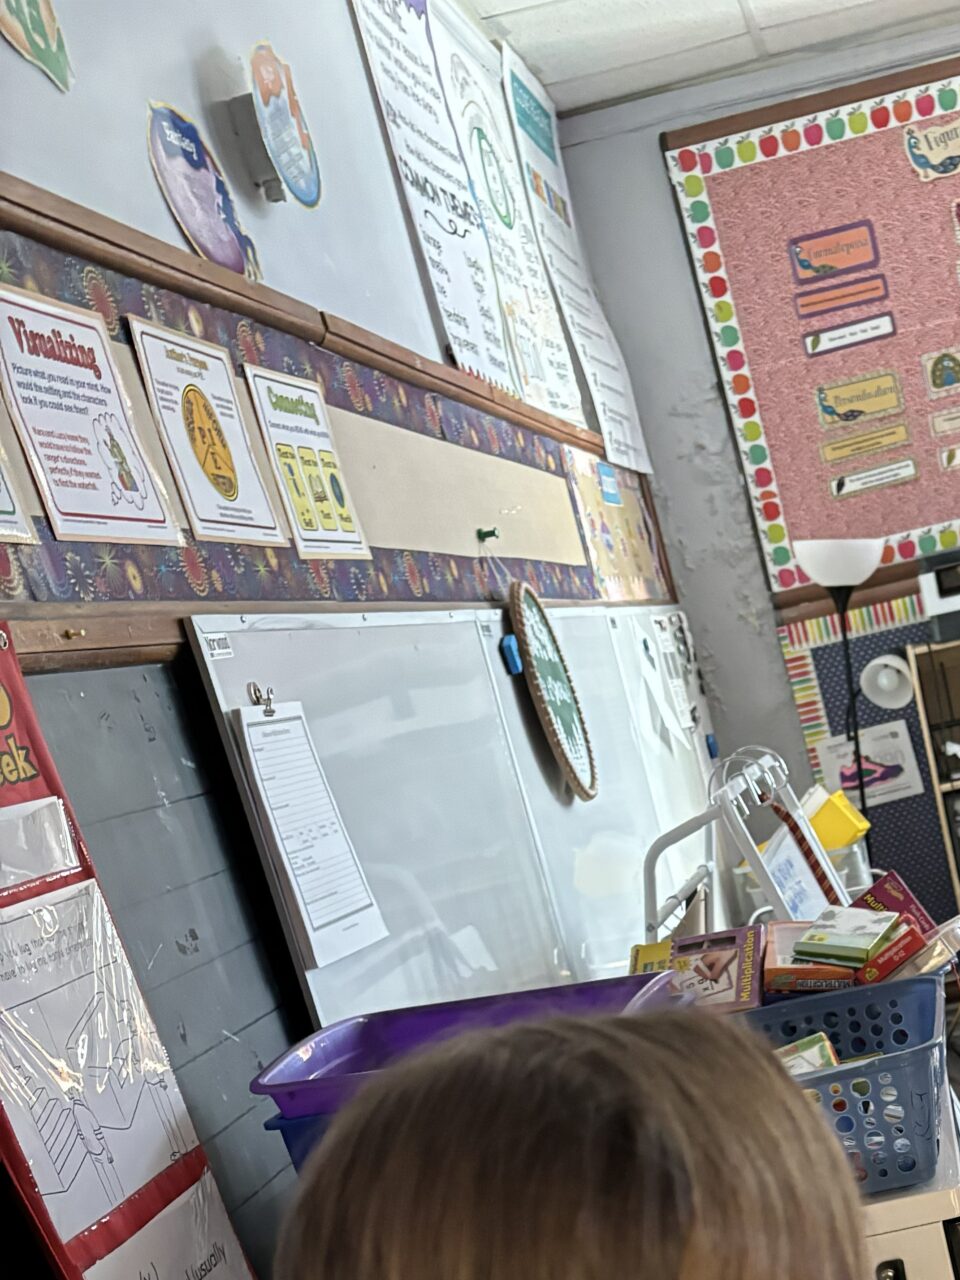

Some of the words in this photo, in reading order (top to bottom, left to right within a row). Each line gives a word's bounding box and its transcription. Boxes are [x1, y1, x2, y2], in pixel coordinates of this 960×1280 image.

[7, 316, 102, 380] Visualizing
[0, 733, 40, 784] ek
[863, 893, 888, 911] Mult
[741, 930, 755, 1002] Multiplication
